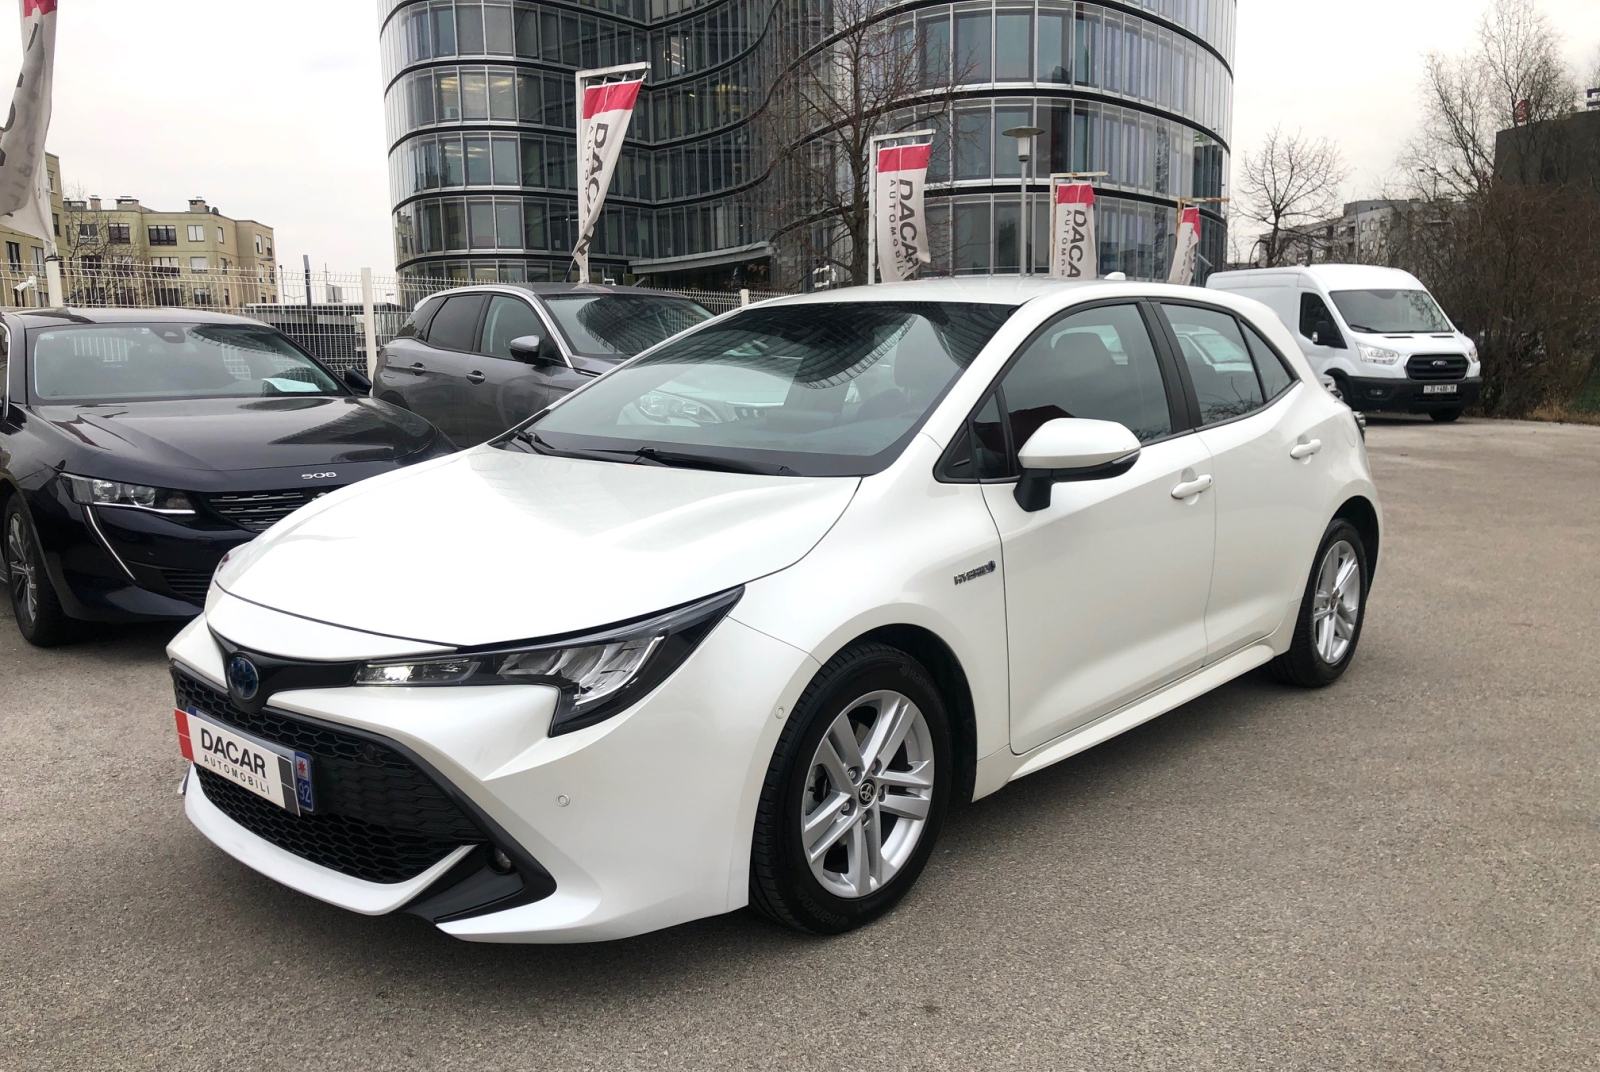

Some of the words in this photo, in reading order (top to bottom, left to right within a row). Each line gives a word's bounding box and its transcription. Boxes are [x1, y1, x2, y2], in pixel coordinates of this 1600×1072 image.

[1067, 210, 1087, 277] DACA
[301, 472, 336, 480] 508
[201, 728, 266, 779] DACAR
[204, 754, 270, 795] AUTOMOBILI
